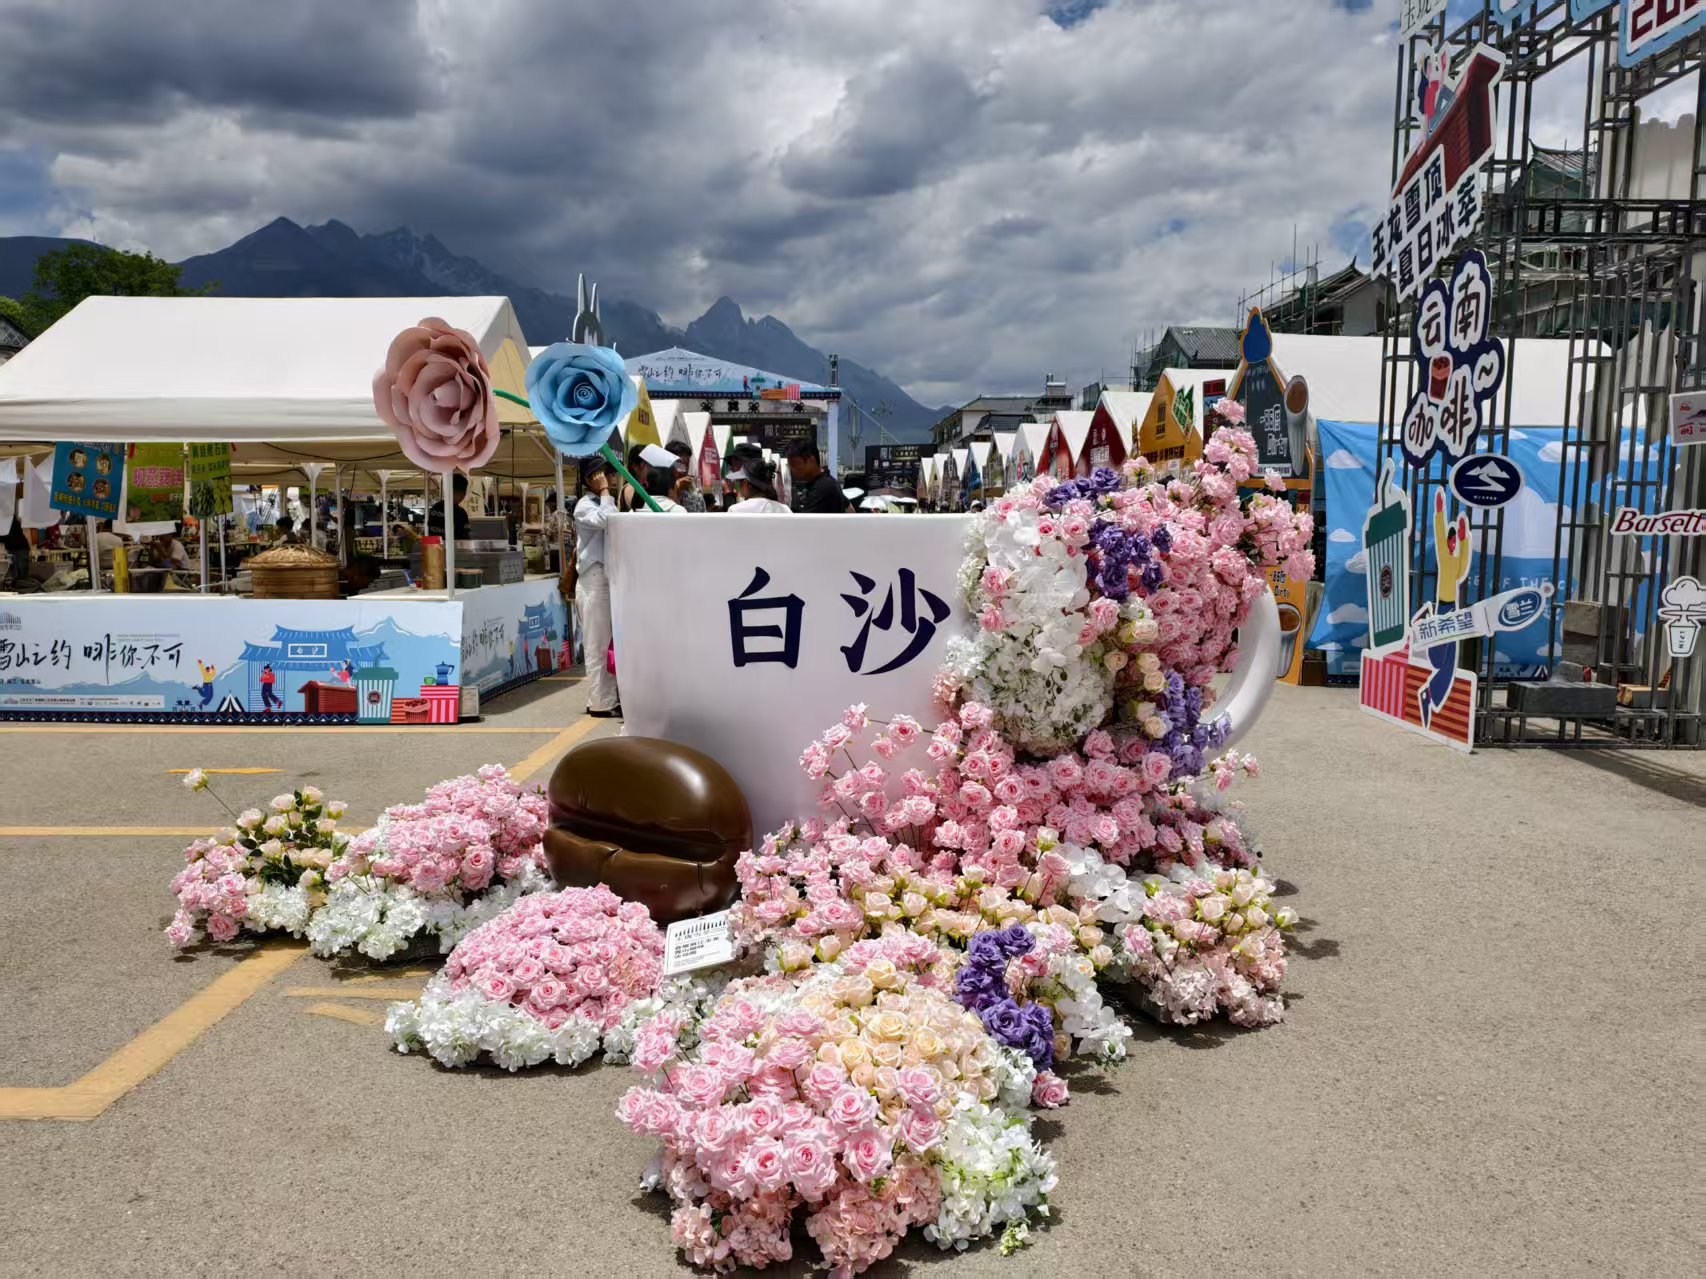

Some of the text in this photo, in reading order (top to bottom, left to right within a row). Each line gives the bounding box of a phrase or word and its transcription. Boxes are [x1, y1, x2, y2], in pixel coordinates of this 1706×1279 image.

[1372, 153, 1442, 272] 玉龙雪顶
[1398, 173, 1478, 294] 夏日冰萃
[1422, 273, 1480, 348] 云南
[1408, 375, 1472, 447] 咖啡
[727, 566, 952, 676] 白沙
[1418, 611, 1475, 640] 新希望
[1506, 598, 1535, 620] 雪兰
[0, 633, 184, 685] 雪山之约 啡你不可
